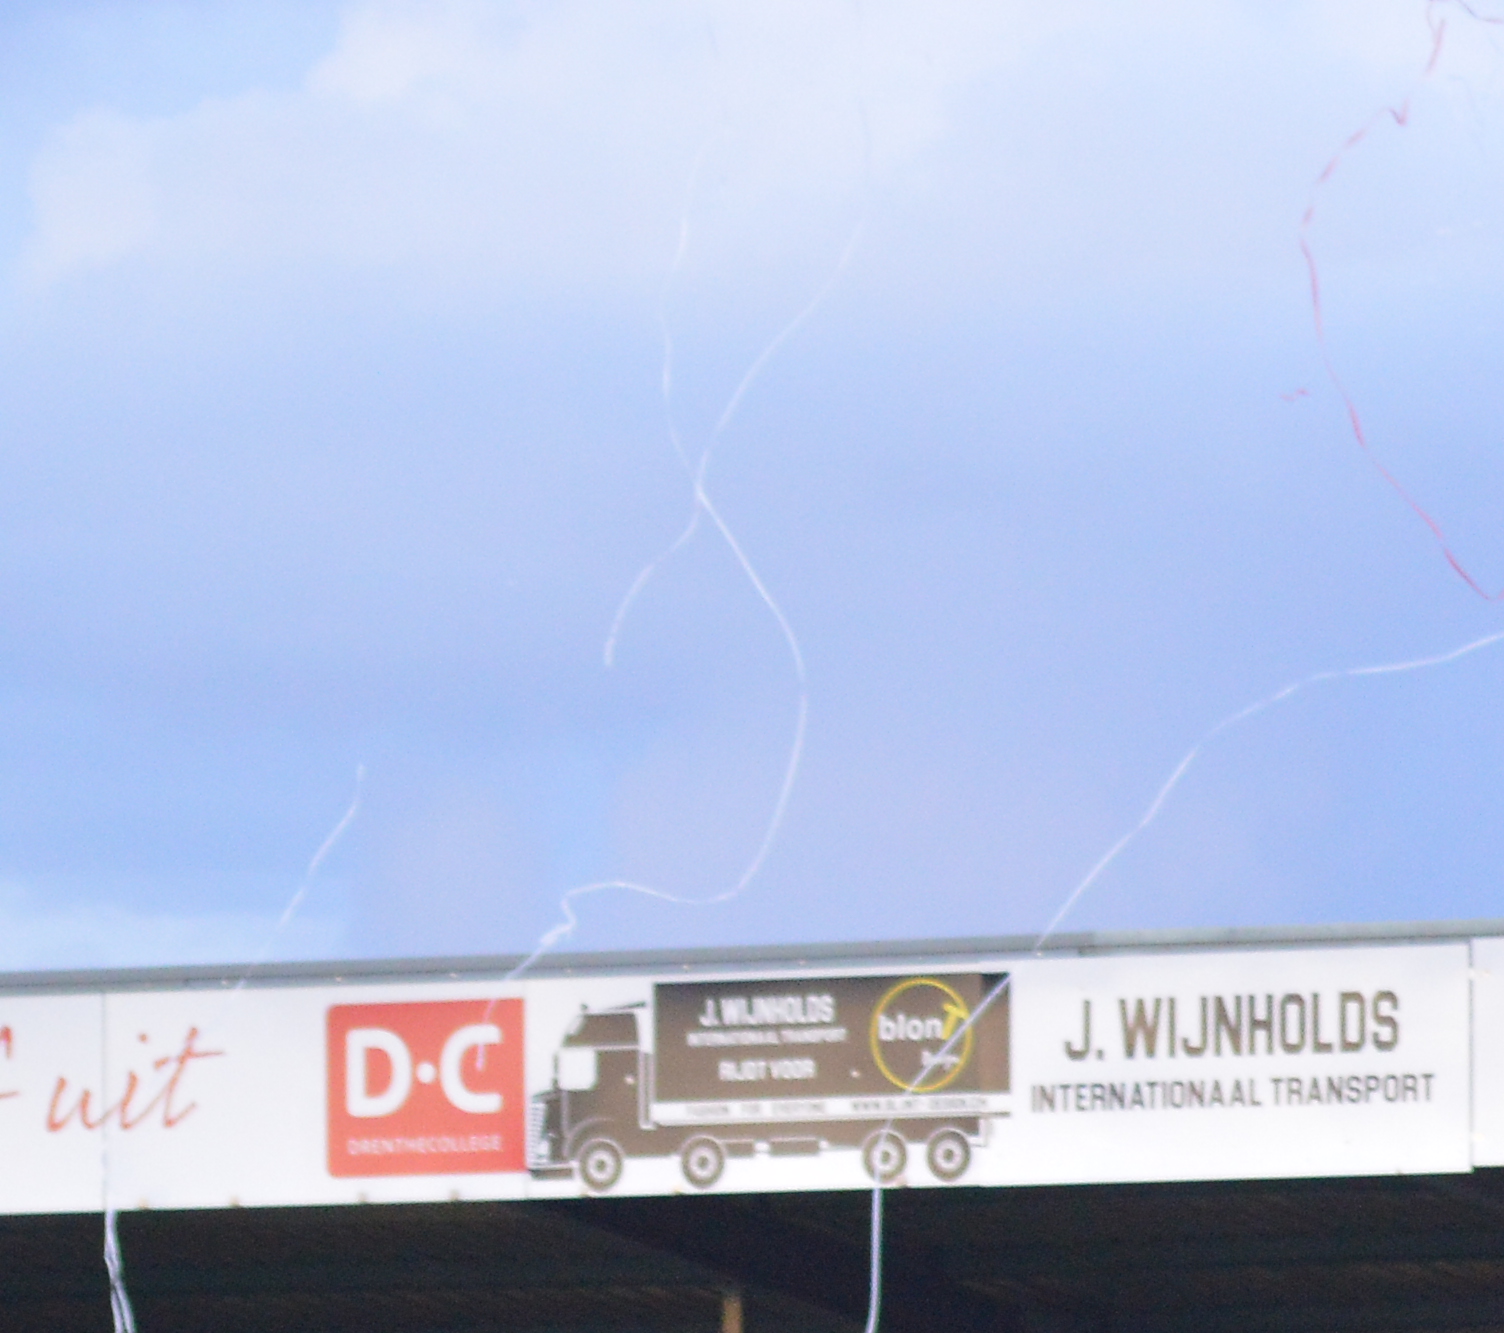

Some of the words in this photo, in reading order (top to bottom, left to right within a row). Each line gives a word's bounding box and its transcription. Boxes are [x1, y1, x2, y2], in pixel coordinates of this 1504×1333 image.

[1064, 1000, 1105, 1061] J.
[1119, 990, 1400, 1059] WIJNHOLDS
[1031, 1078, 1262, 1112] INTERNATIONAAL
[1272, 1073, 1435, 1103] TRANSPORT
